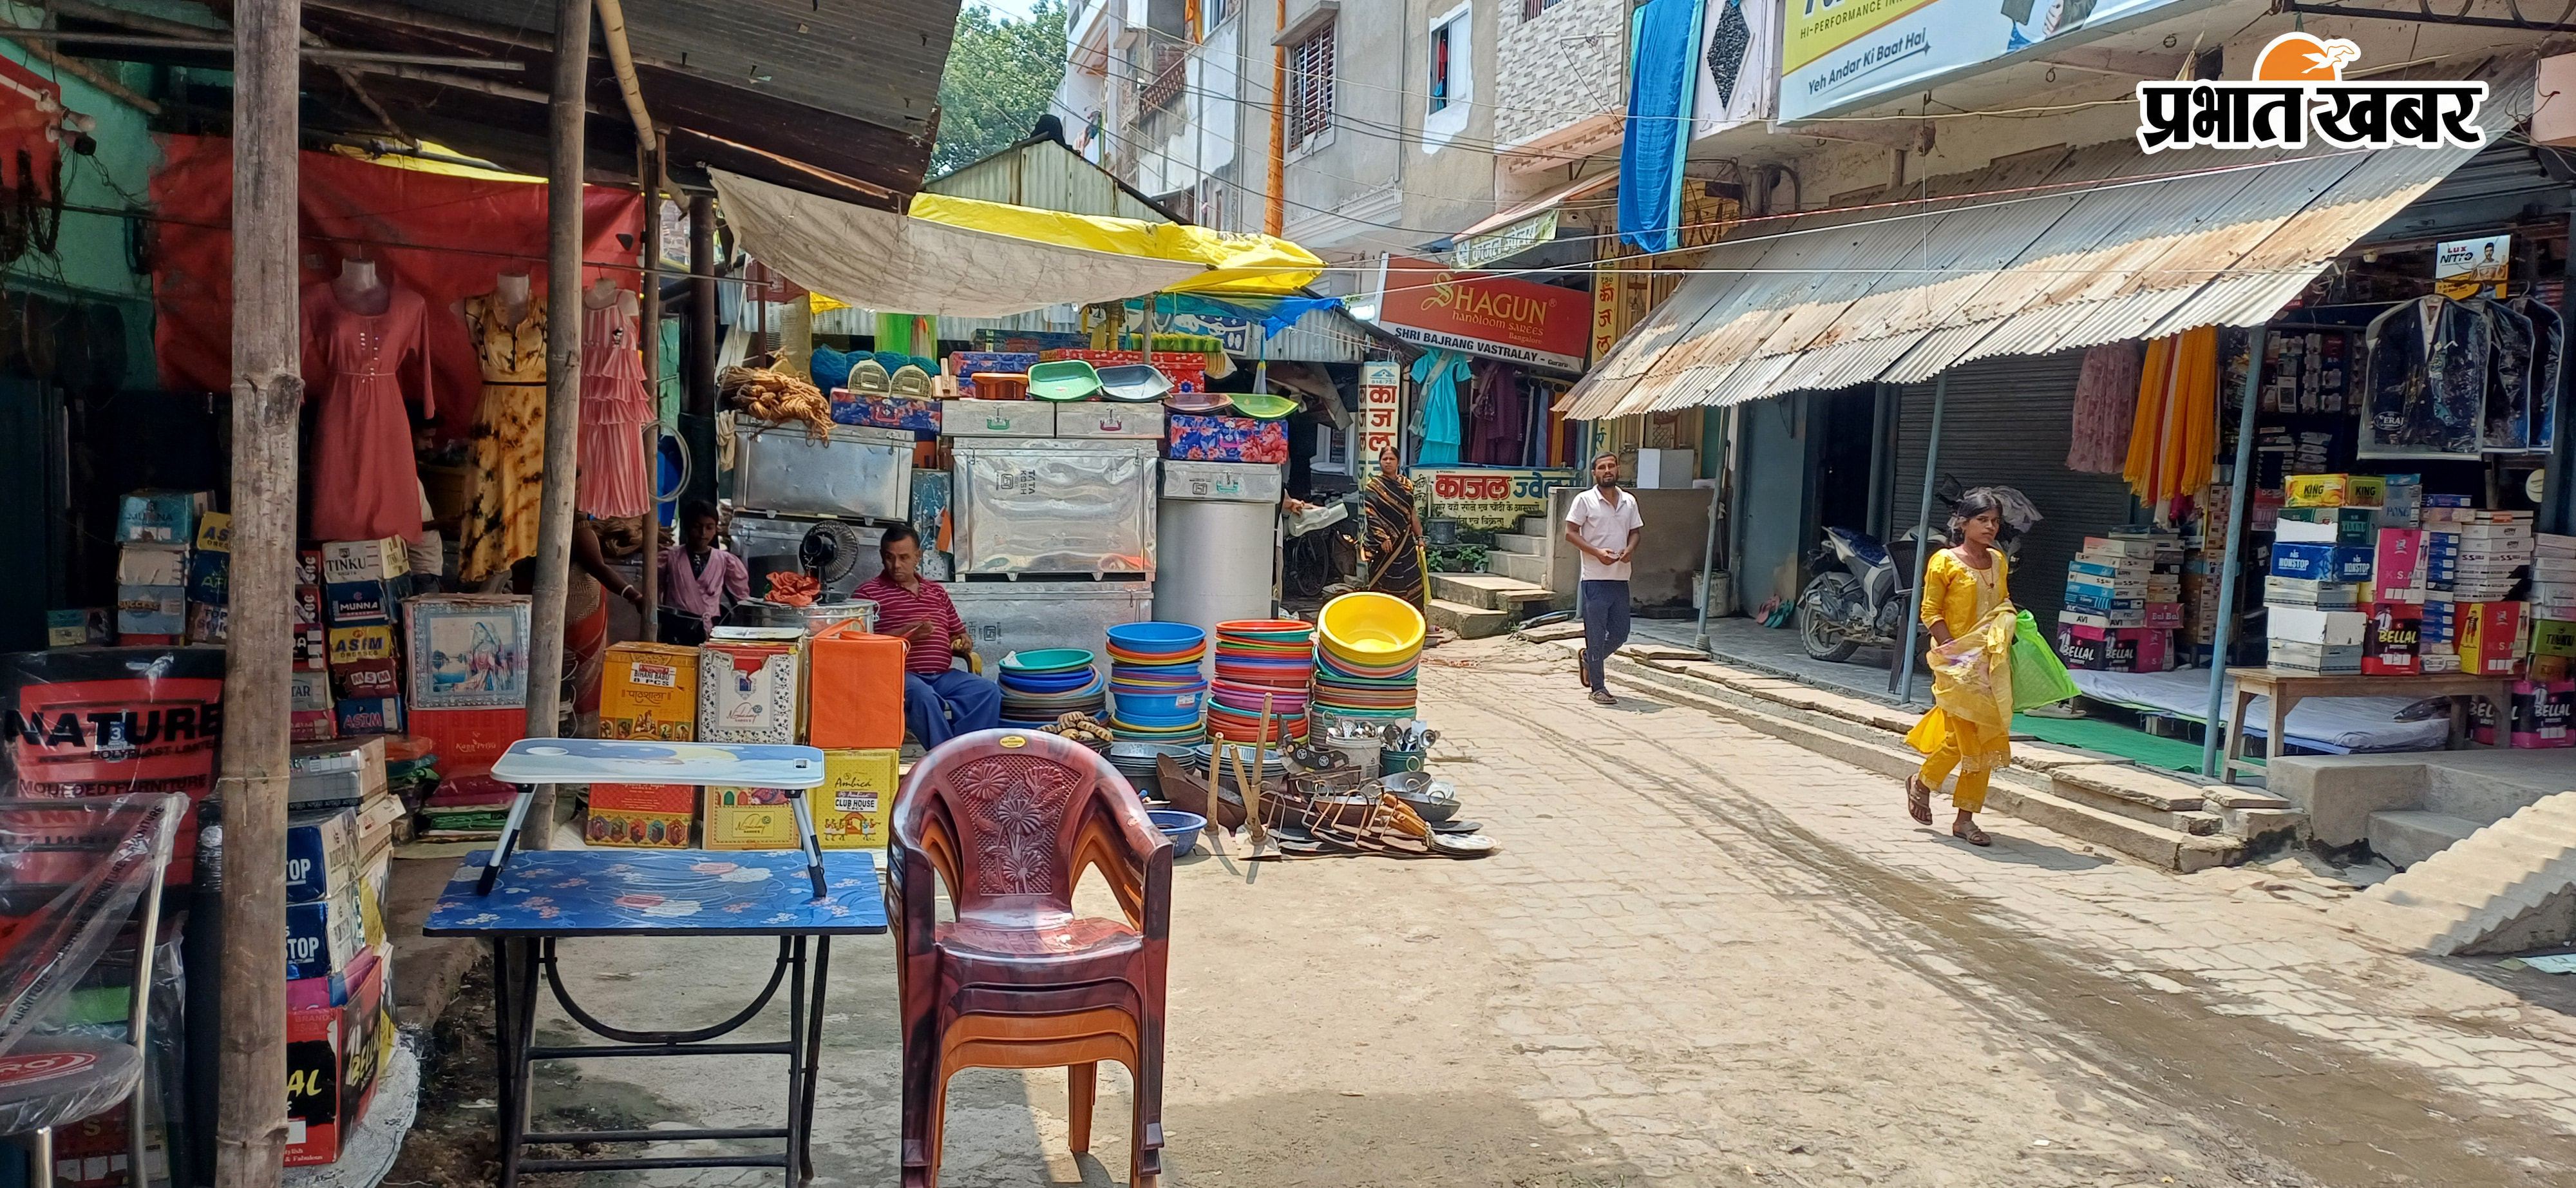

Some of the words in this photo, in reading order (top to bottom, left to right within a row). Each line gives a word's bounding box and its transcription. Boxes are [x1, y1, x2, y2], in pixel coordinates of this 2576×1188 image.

[1801, 1, 1881, 39] HI-PERFORMANCE
[1809, 75, 1826, 95] Yeh
[1828, 57, 1862, 84] Andar
[1863, 48, 1875, 67] Ki
[1877, 37, 1903, 61] Baat
[1905, 27, 1926, 50] Hai
[2440, 252, 2473, 263] NITRO
[1421, 272, 1548, 325] SHAGUN
[1452, 310, 1506, 329] handloom
[1395, 327, 1420, 341] SHRI
[1423, 333, 1474, 351] BAJRANG
[1477, 341, 1538, 363] VASTRALAY
[1508, 332, 1542, 345] Bangalore
[1435, 474, 1511, 501] काजल
[2304, 484, 2324, 495] KING
[2355, 486, 2376, 496] KING
[202, 526, 230, 542] AS
[326, 557, 366, 571] TINKU
[2278, 557, 2309, 570] NONSTOP
[2344, 562, 2370, 573] NONSTOP
[339, 601, 378, 611] MUNNA
[2378, 630, 2418, 644] BELLAL
[336, 637, 384, 653] ASIM
[2061, 645, 2094, 661] BELLAL
[2105, 648, 2134, 659] BELLAL
[353, 672, 390, 683] MSM
[634, 669, 653, 679] BIHARI
[654, 671, 670, 681] BABU
[627, 690, 667, 704] पाठशाला
[2534, 704, 2571, 717] BELLAL
[343, 712, 383, 729] ASIM
[175, 739, 220, 754] LIMITE
[835, 777, 871, 788] Ambica
[853, 800, 875, 808] HOUSE
[10, 973, 52, 1026] FURNITURE
